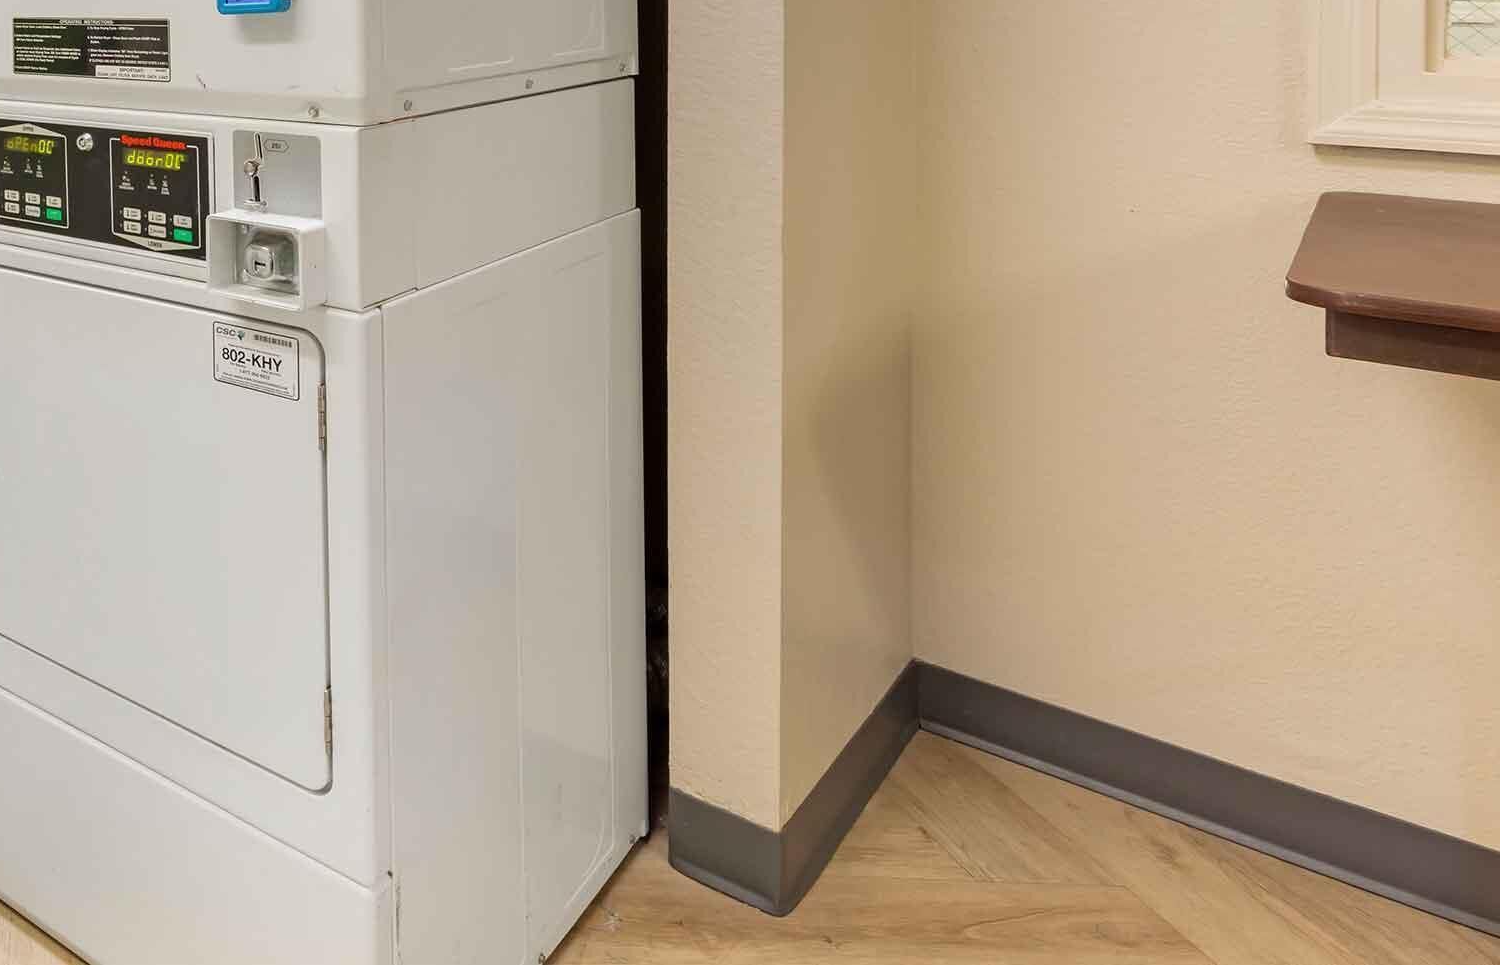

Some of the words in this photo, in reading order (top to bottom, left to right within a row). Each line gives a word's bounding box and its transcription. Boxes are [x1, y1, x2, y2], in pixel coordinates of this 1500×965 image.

[121, 134, 152, 148] Speed
[153, 137, 187, 150] Queen
[216, 326, 236, 337] CSC
[221, 347, 283, 373] 802-KHY
